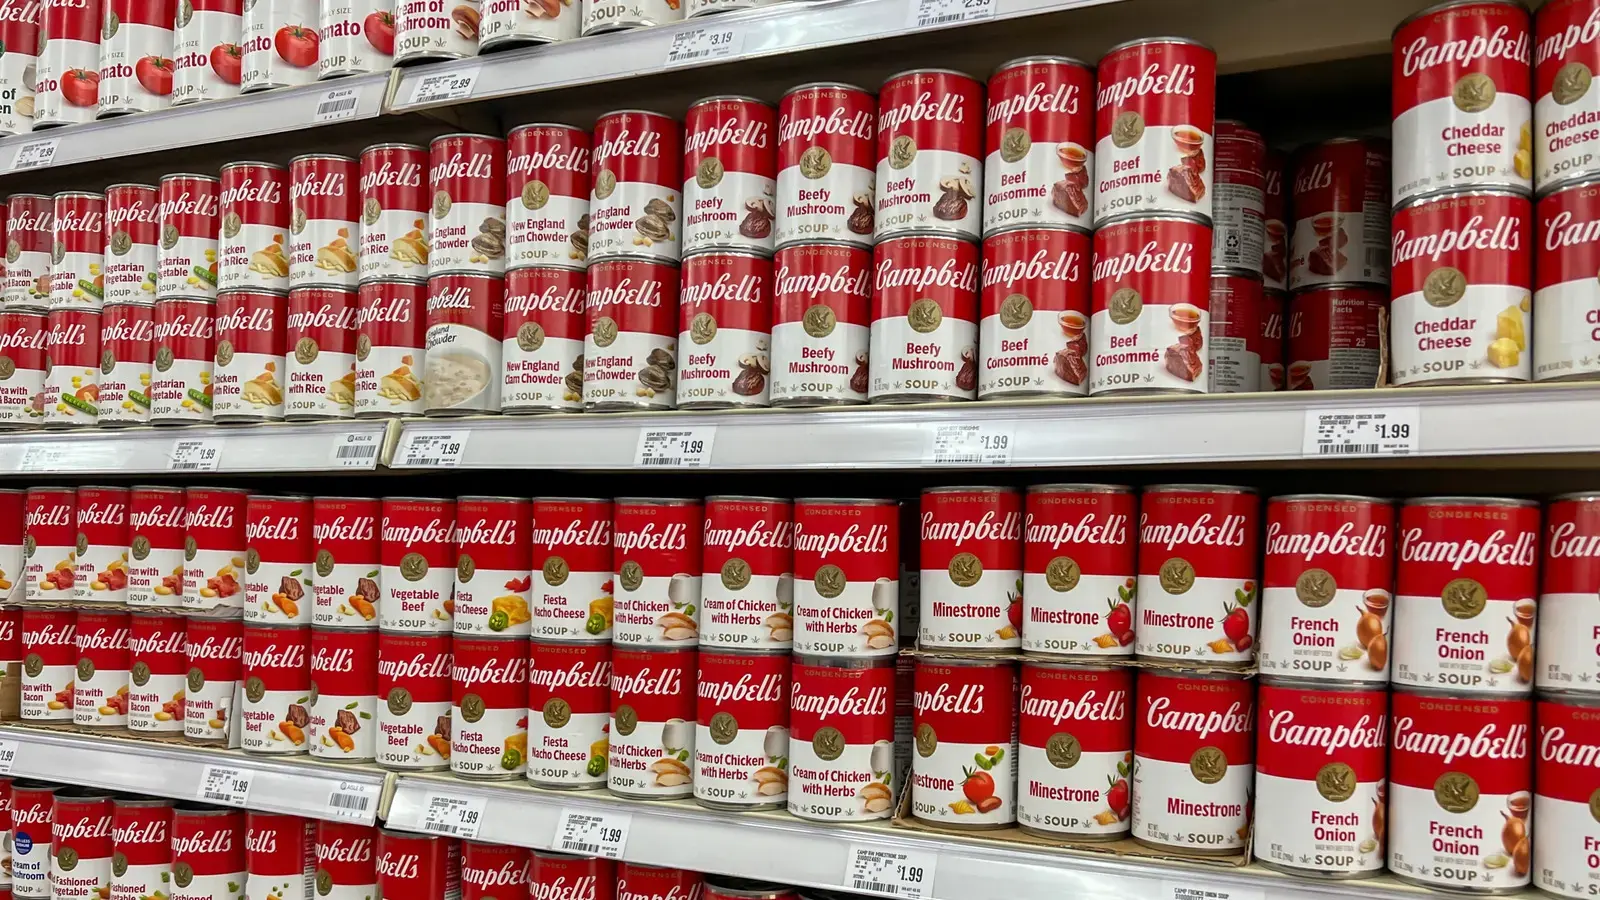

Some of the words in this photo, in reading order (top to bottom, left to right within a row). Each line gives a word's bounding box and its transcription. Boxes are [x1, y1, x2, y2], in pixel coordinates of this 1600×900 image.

[709, 32, 732, 45] $3.19
[320, 55, 346, 69] SOUP
[450, 78, 471, 89] $2.99
[1442, 124, 1505, 141] Cheddar
[1549, 129, 1599, 152] Cheese
[1447, 142, 1501, 156] Cheese
[1114, 157, 1140, 172] Beef
[887, 177, 916, 192] Beefy
[1002, 172, 1026, 186] Beef
[1100, 170, 1161, 192] Consommé
[799, 189, 830, 201] Beefy
[878, 191, 930, 210] Mushroom
[989, 187, 1046, 205] Consommé
[695, 198, 723, 210] Beefy
[1110, 195, 1142, 209] SOUP
[597, 206, 630, 218] England
[787, 203, 844, 217] Mushroom
[687, 211, 737, 225] Mushroom
[527, 219, 564, 230] England
[597, 220, 633, 231] Chowder
[434, 226, 465, 238] England
[526, 232, 568, 243] Chowder
[435, 239, 469, 249] Chowder
[1392, 215, 1520, 267] Campbell's
[370, 245, 388, 254] Rice
[231, 256, 248, 265] Rice
[298, 252, 314, 263] Rice
[17, 268, 31, 277] with
[12, 279, 30, 287] Bacon
[1415, 318, 1476, 334] Cheddar
[1002, 339, 1028, 351] Beef
[1110, 334, 1138, 348] Beef
[1356, 338, 1365, 346] 25
[1418, 337, 1471, 351] Cheese
[802, 348, 834, 361] Beefy
[906, 343, 940, 357] Beefy
[596, 356, 632, 367] England
[689, 353, 716, 367] Beefy
[987, 353, 1048, 369] Consommé
[1096, 349, 1159, 367] Consommé
[506, 361, 521, 371] New
[522, 361, 559, 372] England
[789, 362, 848, 375] Mushroom
[892, 358, 954, 371] Mushroom
[291, 372, 322, 382] Chicken
[505, 374, 520, 384] Clam
[522, 374, 563, 385] Chowder
[596, 370, 636, 381] Chowder
[681, 368, 730, 381] Mushroom
[1107, 374, 1140, 385] SOUP
[10, 386, 28, 394] with
[222, 385, 240, 394] Rice
[289, 384, 304, 393] with
[305, 384, 325, 393] Rice
[362, 381, 377, 390] Rice
[3, 395, 26, 404] Bacon
[1375, 424, 1409, 438] $1.99
[681, 440, 703, 453] $1.99
[981, 435, 1008, 449] $1.99
[200, 449, 215, 459] $1.99
[441, 443, 460, 454] $1.99
[1428, 511, 1508, 520] CONDENSED
[921, 511, 1022, 546] Campbell's
[794, 523, 888, 558] Campbell's
[1266, 522, 1386, 561] Campbell's
[1402, 528, 1535, 571] Campbell's
[140, 567, 159, 577] with
[130, 578, 149, 587] Bacon
[391, 588, 439, 600] Vegetable
[457, 591, 472, 601] Fiesta
[317, 596, 332, 606] Beef
[402, 602, 425, 611] Beef
[544, 595, 567, 606] Fiesta
[624, 601, 631, 610] of
[632, 600, 669, 611] Chicken
[704, 598, 724, 610] Cream
[726, 600, 736, 610] of
[738, 599, 776, 611] Chicken
[462, 605, 488, 615] Cheese
[534, 607, 552, 617] Nacho
[553, 608, 585, 618] Cheese
[797, 605, 818, 617] Cream
[821, 607, 831, 617] of
[832, 607, 873, 619] Chicken
[933, 602, 1000, 617] Minestrone
[1031, 607, 1099, 624] Minestrone
[628, 614, 653, 625] Herbs
[712, 612, 729, 623] with
[731, 614, 761, 625] Herbs
[1144, 610, 1214, 629] Minestrone
[1291, 617, 1338, 631] French
[806, 621, 824, 632] with
[826, 622, 857, 633] Herbs
[948, 634, 981, 642] SOUP
[1293, 633, 1334, 647] Onion
[1436, 628, 1488, 644] French
[814, 643, 844, 652] SOUP
[1439, 645, 1484, 660] Onion
[1293, 660, 1332, 672] SOUP
[35, 683, 52, 693] with
[23, 693, 43, 701] Bacon
[791, 682, 886, 720] Campbell's
[1020, 685, 1125, 725] Campbell's
[1419, 702, 1499, 713] CONDENSED
[246, 722, 261, 731] Beef
[380, 722, 423, 734] Vegetable
[388, 736, 408, 746] Beef
[461, 730, 483, 741] Fiesta
[1394, 717, 1527, 764] Campbell's
[544, 737, 568, 747] Fiesta
[470, 744, 500, 754] Cheese
[532, 748, 552, 758] Nacho
[554, 750, 586, 760] Cheese
[617, 745, 624, 754] of
[626, 746, 662, 757] Chicken
[621, 759, 646, 770] Herbs
[714, 753, 723, 764] of
[725, 754, 764, 766] Chicken
[701, 767, 717, 778] with
[719, 769, 748, 780] Herbs
[793, 765, 816, 780] Cream
[818, 768, 829, 780] of
[831, 770, 871, 782] Chicken
[232, 780, 248, 792] $1.99
[802, 783, 822, 795] with
[824, 785, 855, 797] Herbs
[1030, 781, 1099, 802] Minestrone
[1168, 798, 1241, 817] Minestrone
[459, 810, 478, 823] $1.99
[1312, 811, 1358, 825] French
[600, 828, 621, 842] $1.99
[1314, 827, 1355, 841] Onion
[1430, 821, 1483, 839] French
[1432, 838, 1479, 855] Onion
[31, 862, 40, 870] of
[897, 865, 923, 882] $1.99
[1434, 867, 1477, 881] SOUP
[56, 876, 98, 886] Fashioned
